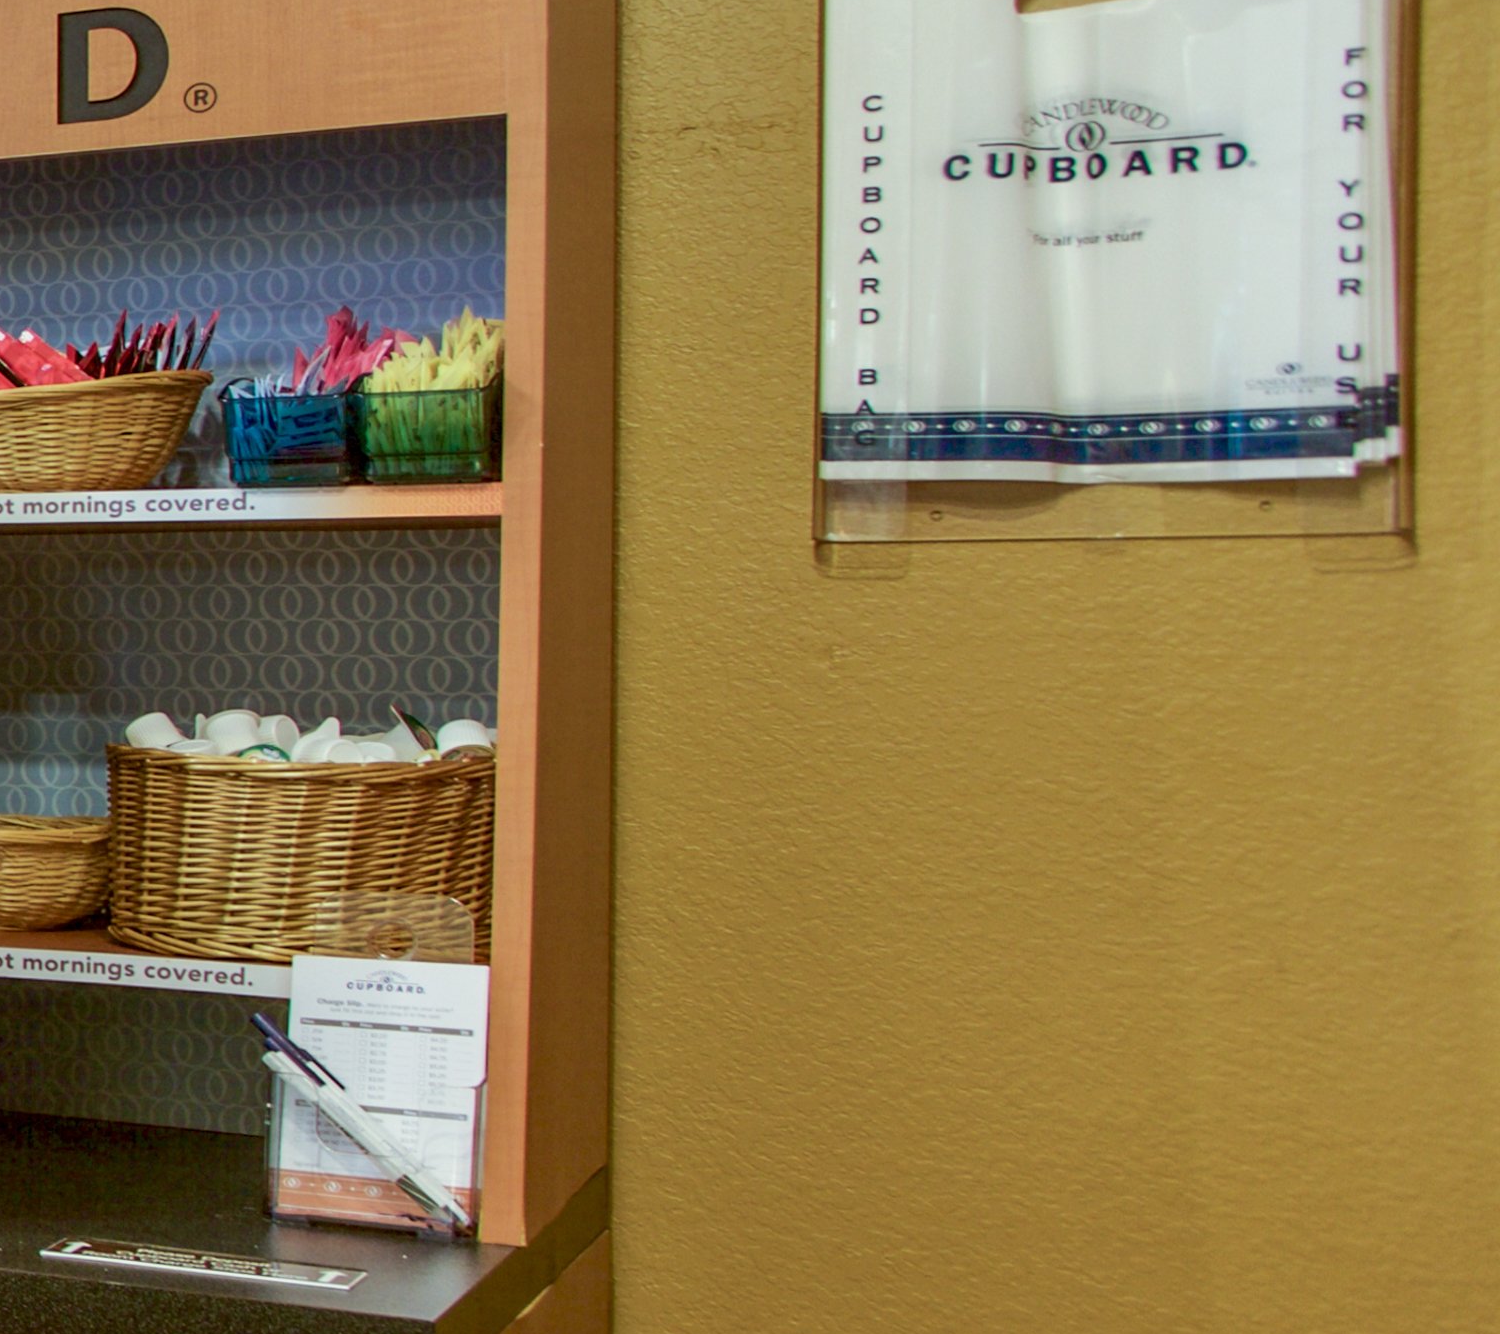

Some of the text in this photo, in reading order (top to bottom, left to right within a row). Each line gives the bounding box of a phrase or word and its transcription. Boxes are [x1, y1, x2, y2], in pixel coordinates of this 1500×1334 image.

[1340, 46, 1367, 134] FOR
[1020, 98, 1170, 137] CANDLEWOOD
[942, 141, 1250, 183] CUPBOARD
[858, 94, 885, 327] CUPBOARD
[1105, 230, 1144, 244] stuff
[1337, 178, 1365, 298] YOUR
[22, 495, 137, 519] mornings
[144, 491, 257, 514] covered.
[22, 952, 137, 981] mornings
[143, 963, 255, 988] covered.
[347, 981, 425, 995] CUPBOARD
